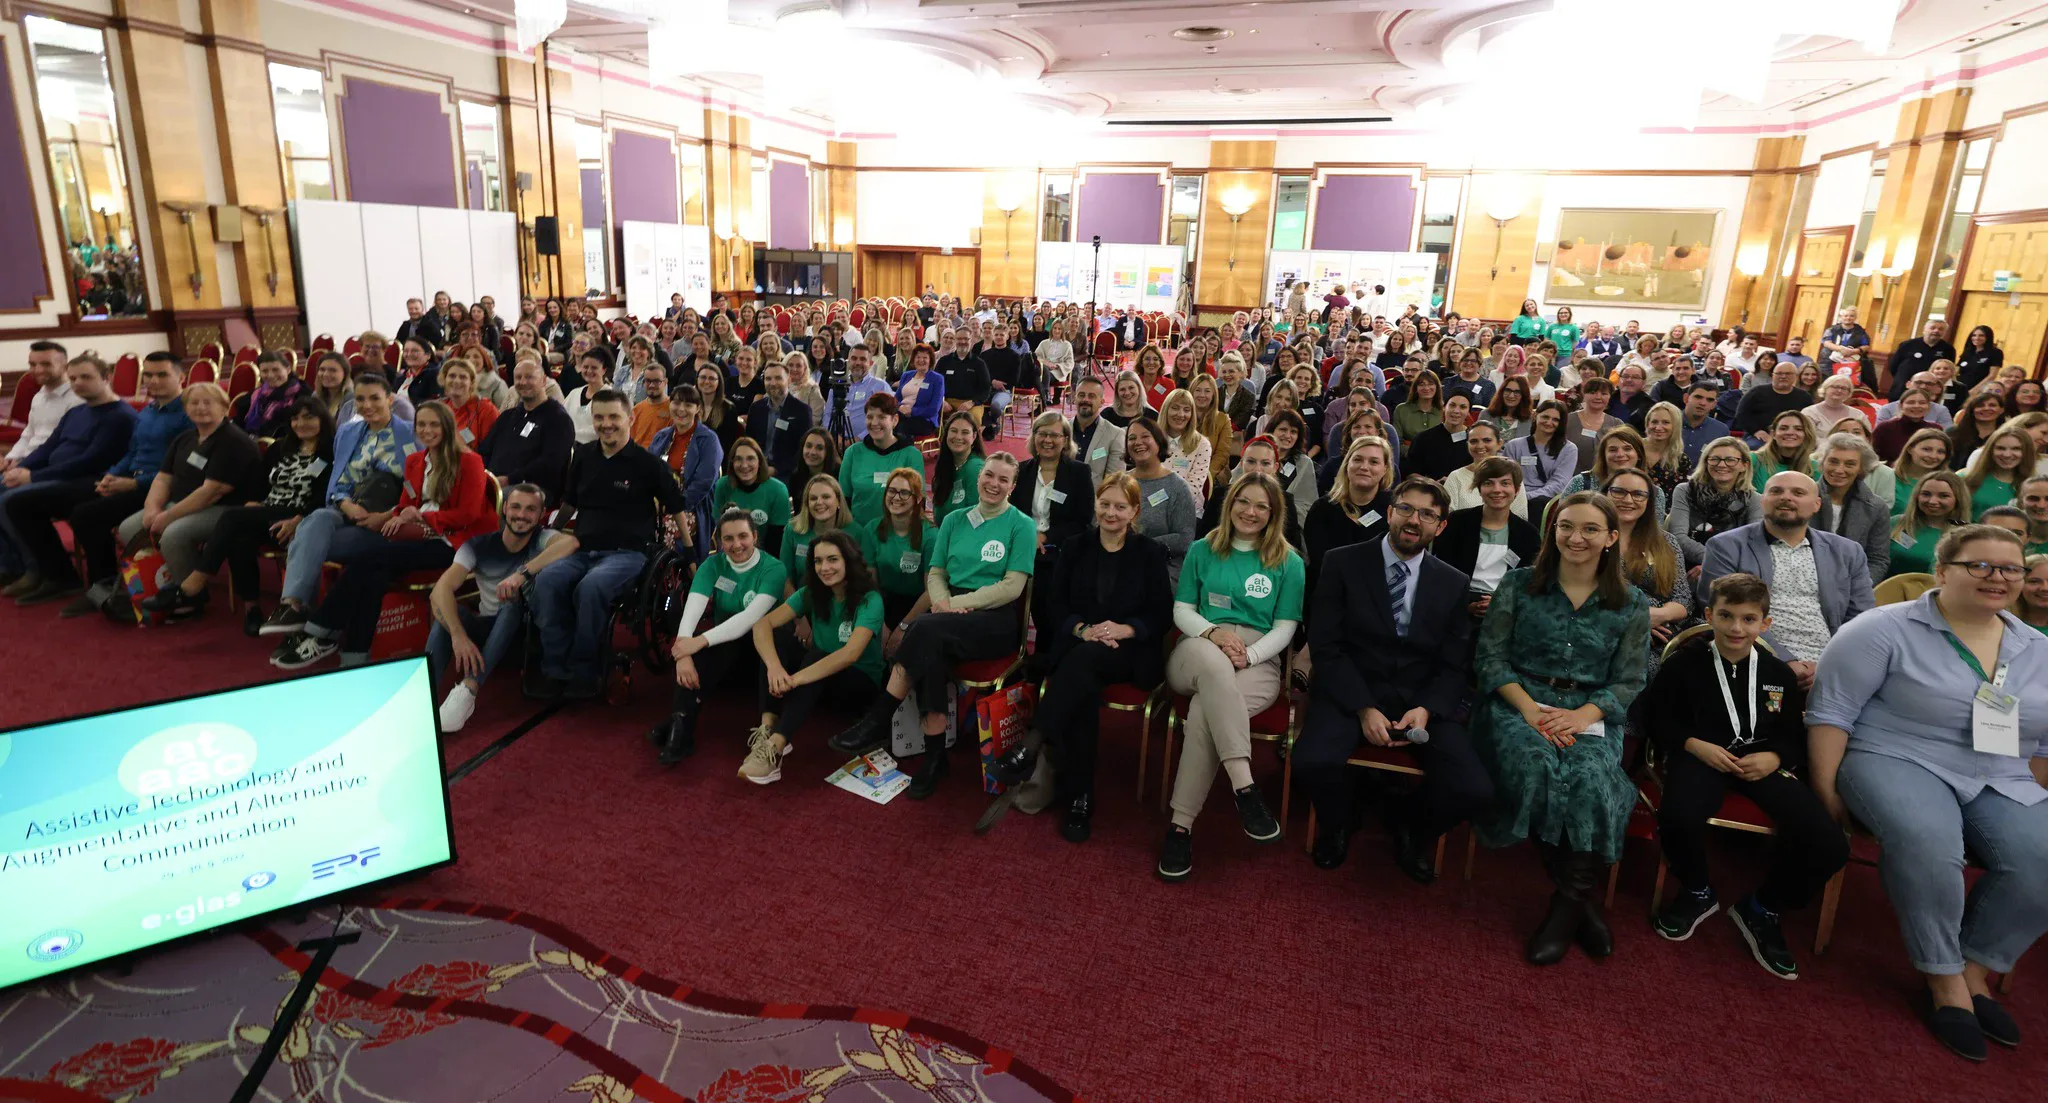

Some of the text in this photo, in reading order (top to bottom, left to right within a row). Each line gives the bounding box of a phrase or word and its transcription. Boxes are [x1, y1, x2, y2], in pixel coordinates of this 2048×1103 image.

[989, 543, 999, 551] at
[983, 550, 1002, 558] aac
[1254, 577, 1265, 586] at
[1247, 584, 1269, 594] aac
[26, 752, 345, 840] Assistive Techonology and
[3, 776, 367, 872] Augmentative and Alternative
[104, 815, 296, 872] Communication
